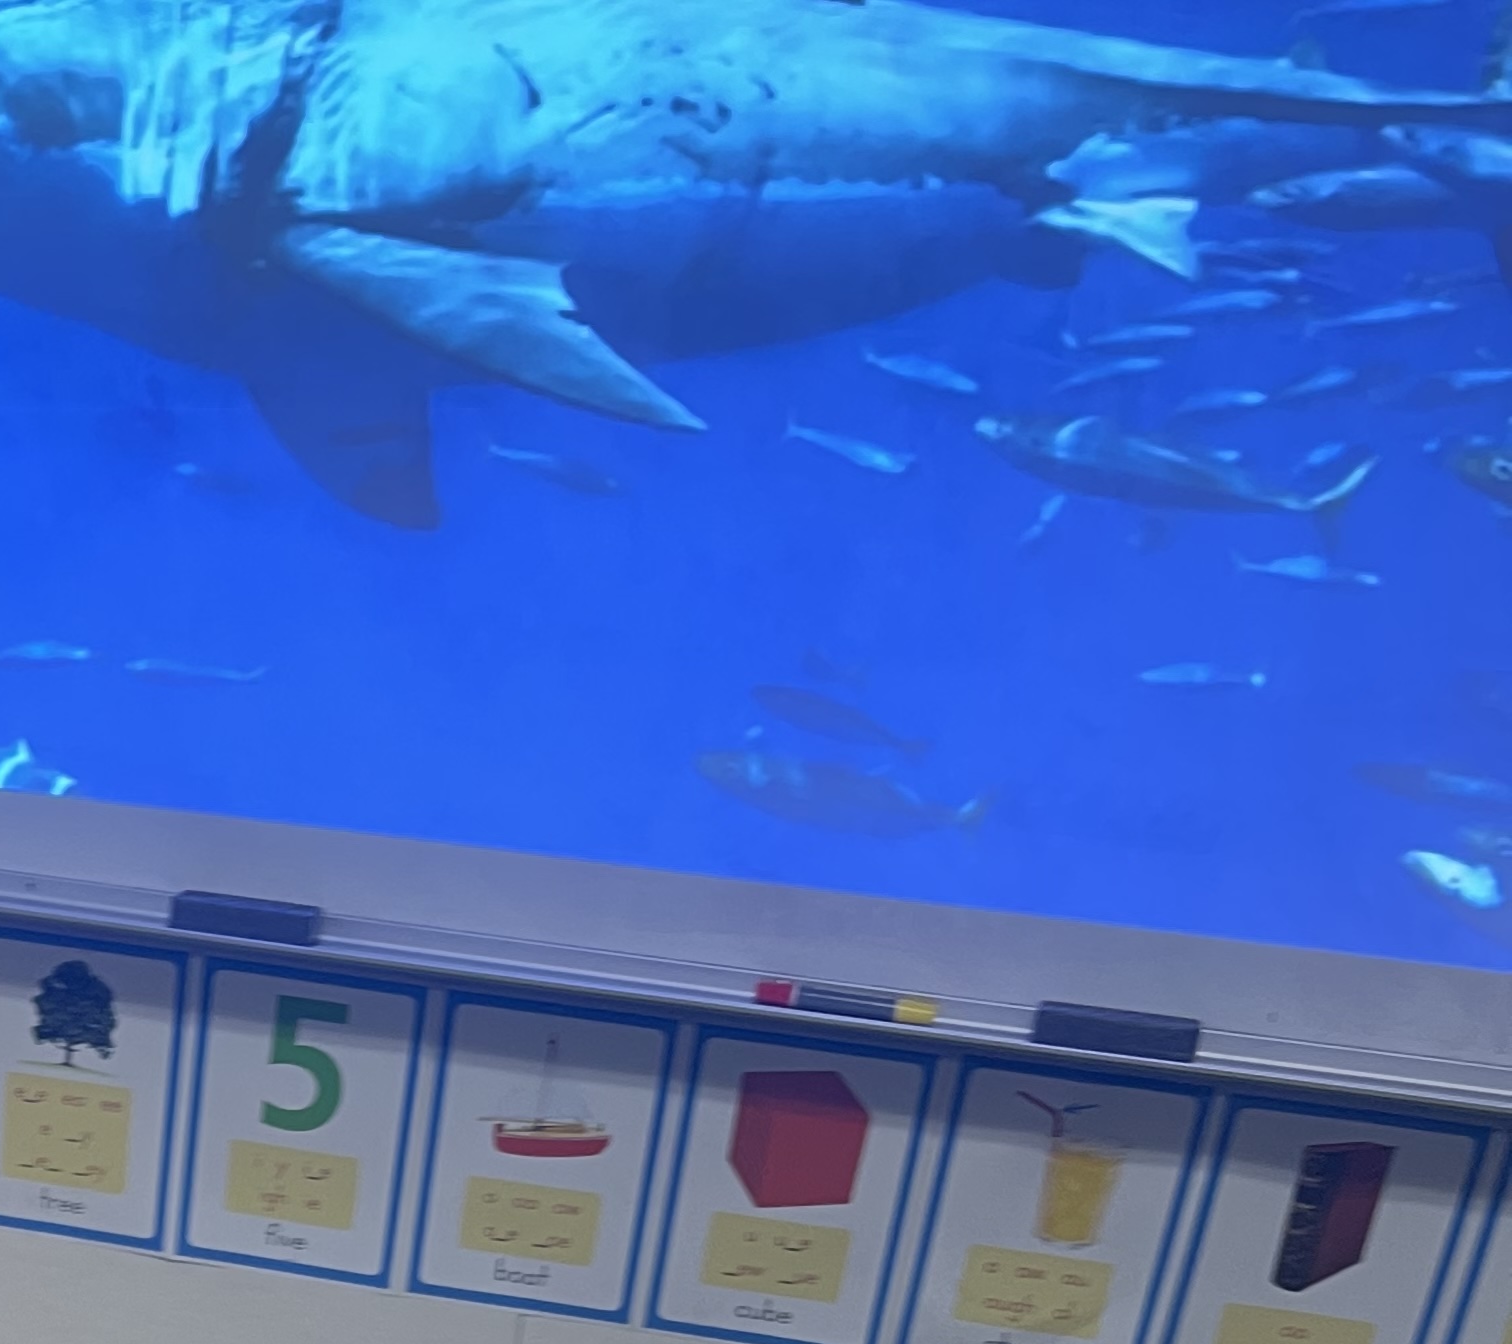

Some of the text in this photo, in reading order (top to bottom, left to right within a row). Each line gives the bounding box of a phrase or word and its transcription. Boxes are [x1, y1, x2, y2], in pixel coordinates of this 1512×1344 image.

[260, 993, 352, 1132] 5
[40, 1187, 87, 1215] tree
[264, 1222, 308, 1250] five
[494, 1257, 550, 1286] boat
[733, 1300, 794, 1325] cube
